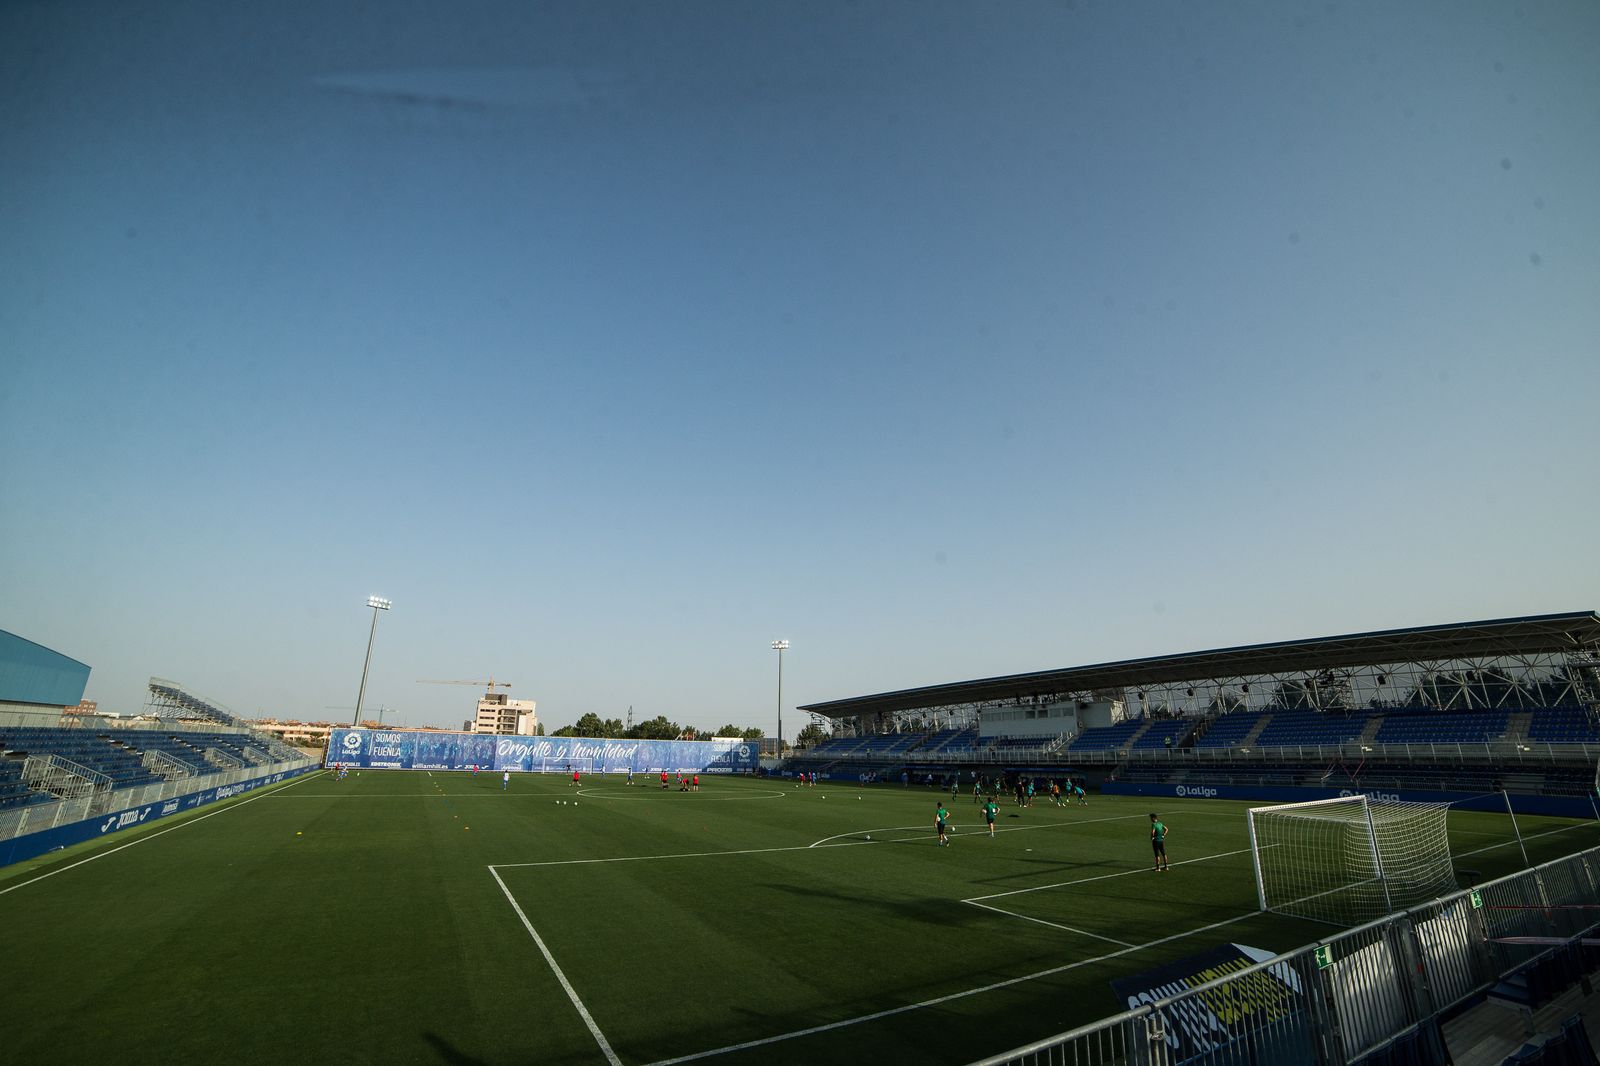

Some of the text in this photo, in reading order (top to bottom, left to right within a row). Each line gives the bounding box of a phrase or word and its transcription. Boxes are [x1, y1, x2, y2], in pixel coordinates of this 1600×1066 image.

[375, 733, 401, 743] SOMOS
[373, 746, 401, 757] FUENLA
[498, 739, 638, 764] Orgullo y humildad
[1186, 785, 1217, 797] LaLiga
